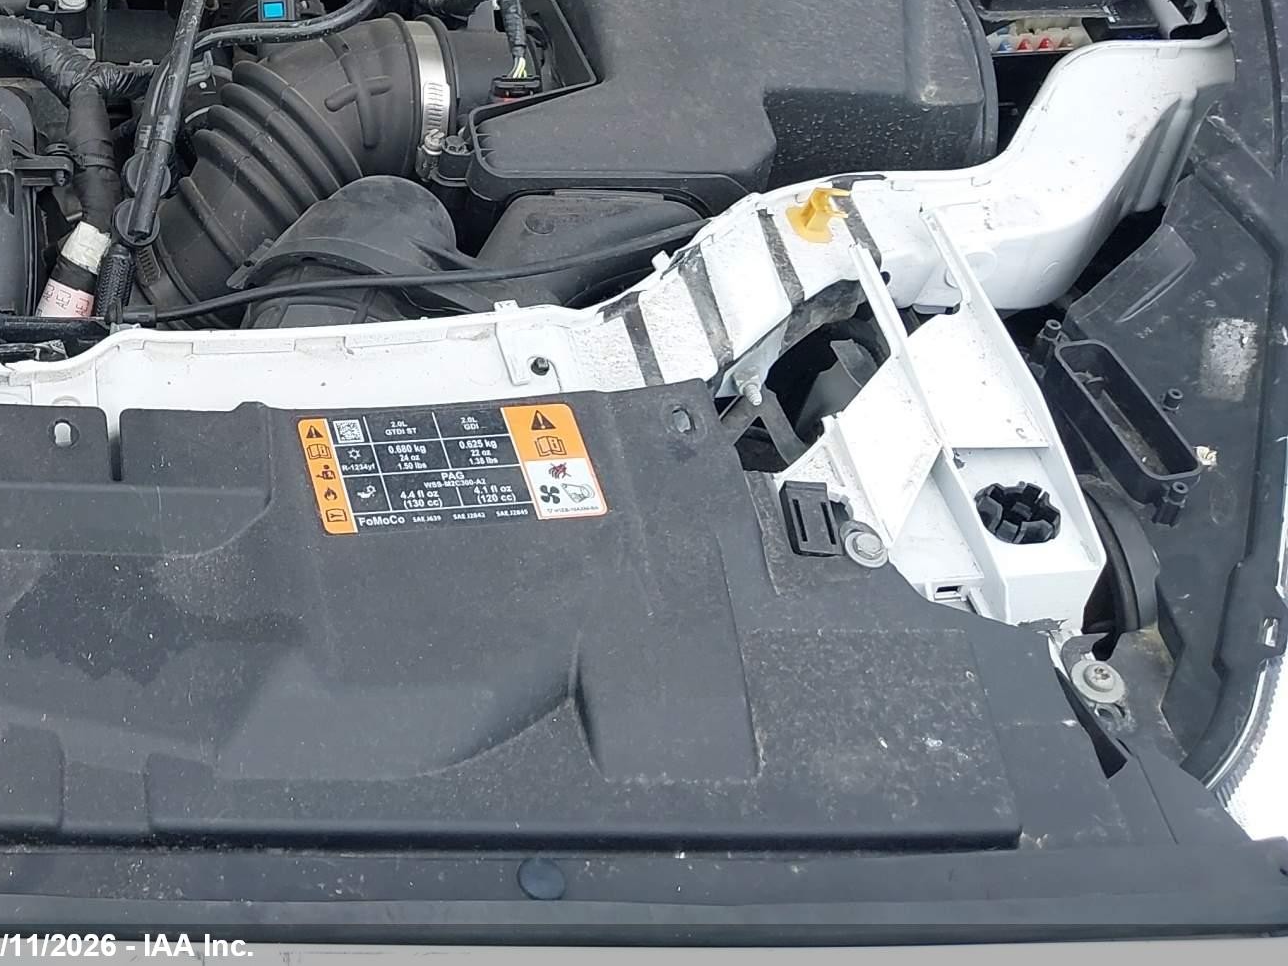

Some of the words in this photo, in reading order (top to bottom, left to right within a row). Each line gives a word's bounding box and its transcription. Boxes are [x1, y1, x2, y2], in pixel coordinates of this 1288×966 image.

[56, 290, 72, 310] AEJ
[388, 445, 412, 454] 0.680
[414, 444, 427, 454] kg
[459, 440, 482, 449] 0.625
[484, 439, 498, 449] kg
[399, 454, 410, 462] 24
[440, 472, 465, 480] PAG
[400, 491, 415, 499] 4.4
[417, 490, 424, 498] fl
[474, 486, 488, 494] 4.1
[490, 485, 498, 493] fl
[403, 499, 425, 510] (130
[427, 497, 443, 508] cc)
[477, 494, 498, 505] (120
[500, 492, 516, 503] cc)
[358, 515, 405, 527] FoMoCo
